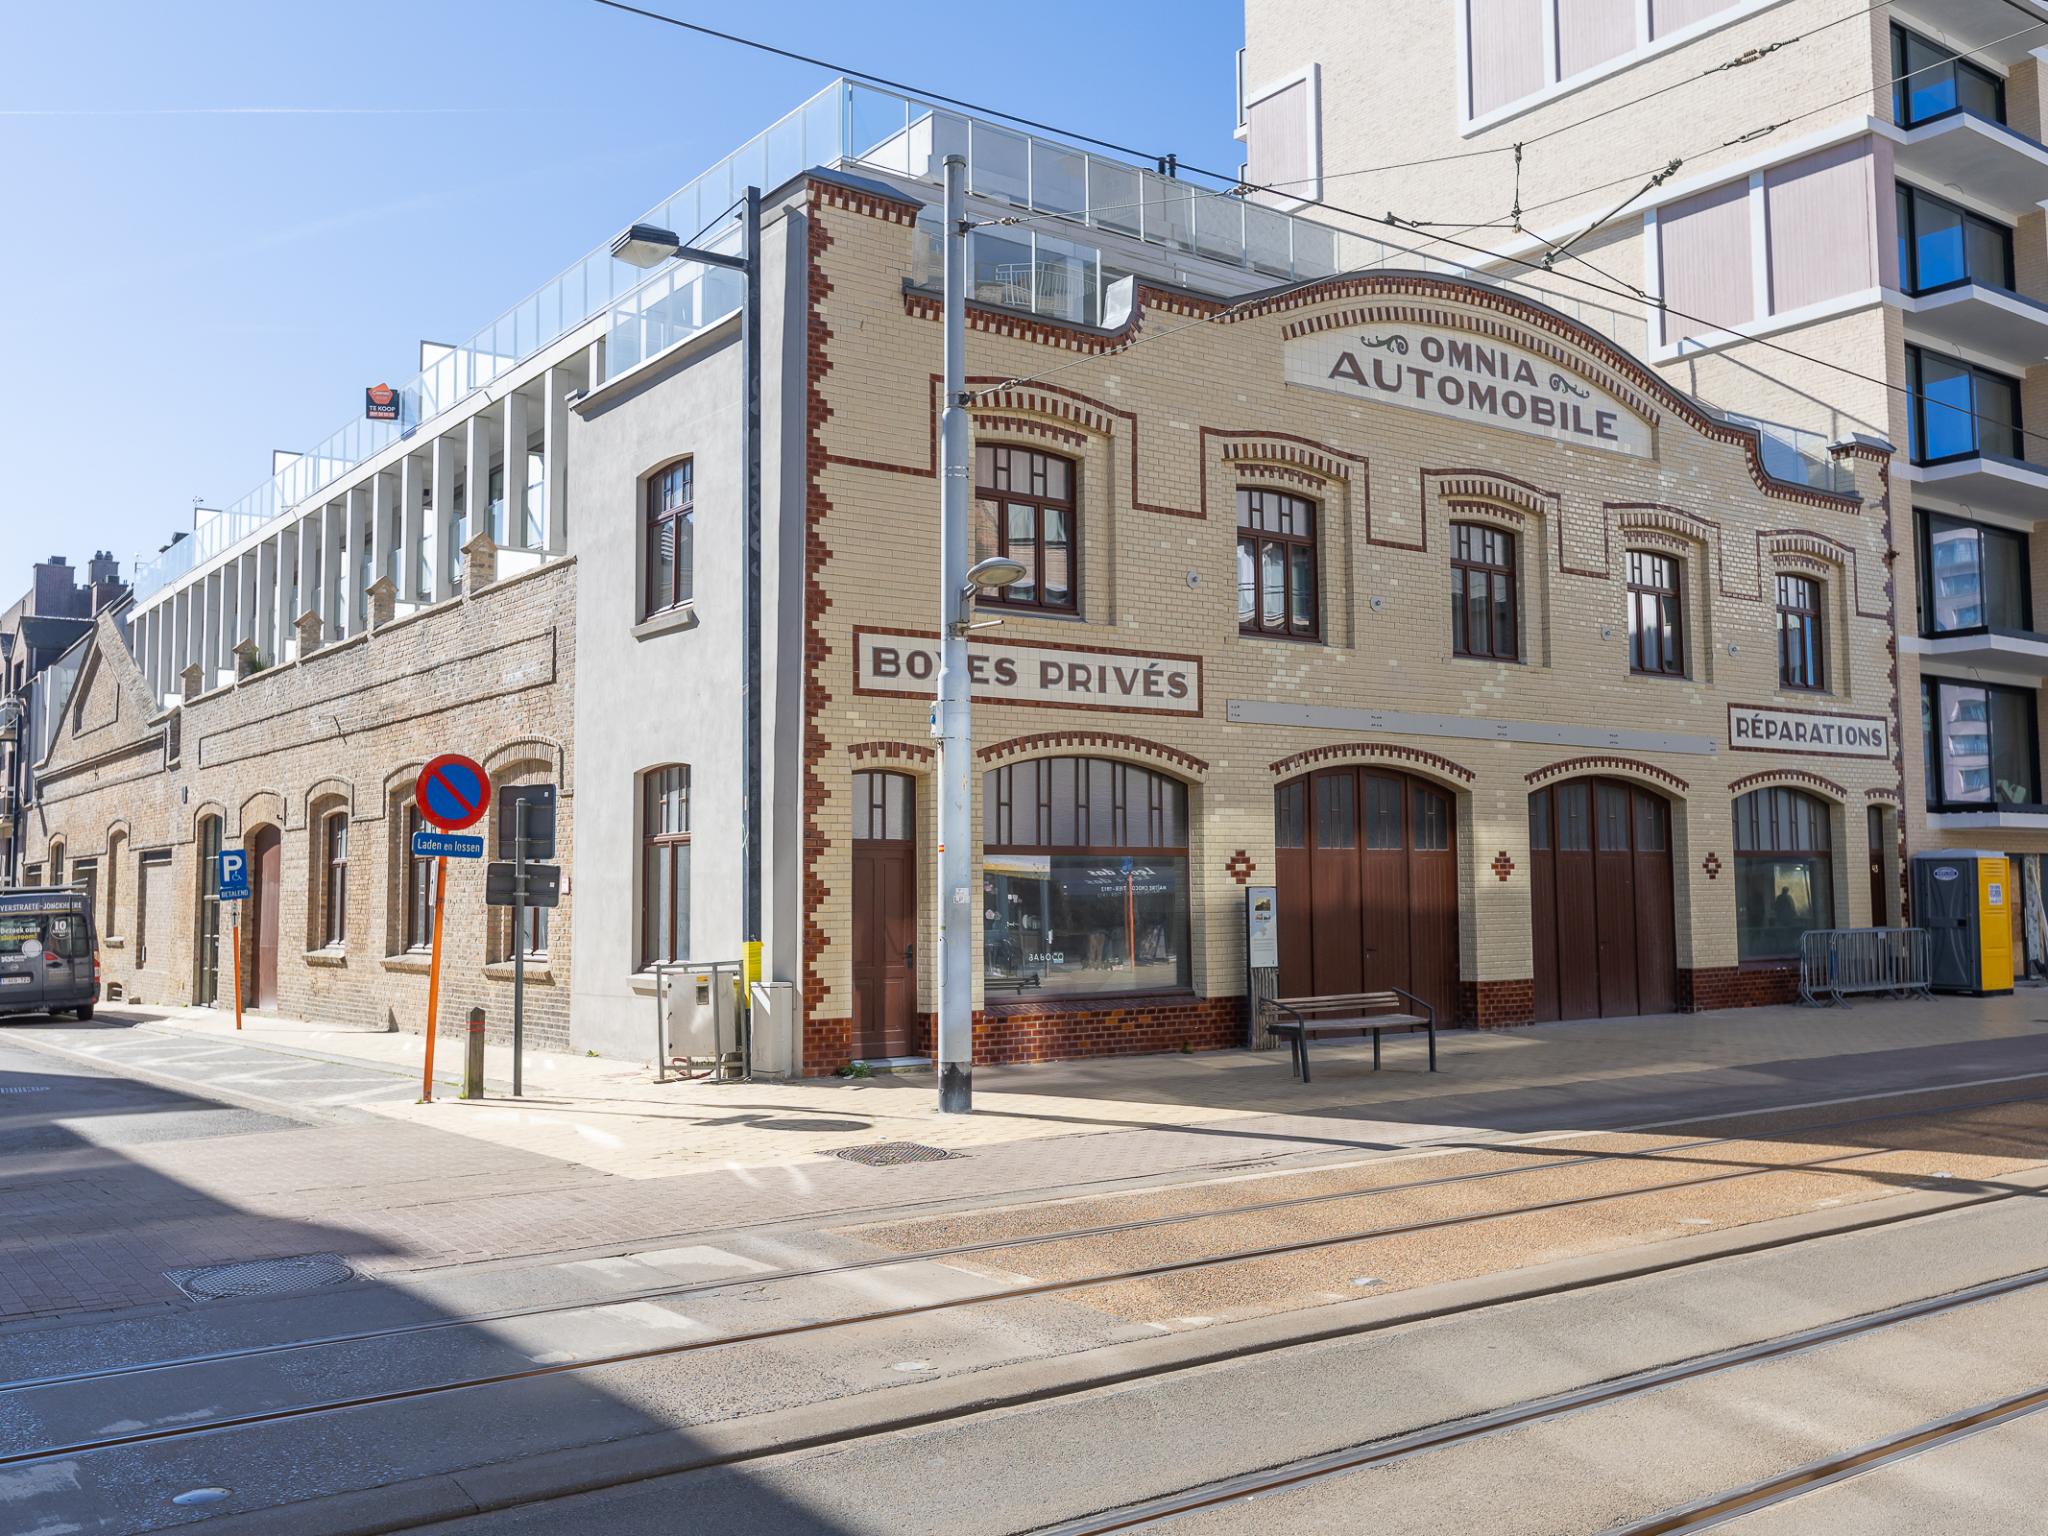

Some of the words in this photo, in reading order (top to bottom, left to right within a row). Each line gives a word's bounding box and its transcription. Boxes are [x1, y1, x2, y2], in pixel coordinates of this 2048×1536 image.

[1420, 336, 1538, 387] OMNIA
[1328, 351, 1619, 441] AUTOMOBILE
[872, 646, 1018, 687] BOES
[1039, 661, 1188, 698] PRIVÉS
[1736, 713, 1883, 747] RÉPARATIONS
[417, 838, 442, 850] Laden
[443, 844, 453, 852] en
[454, 841, 480, 853] lossen
[223, 855, 243, 882] P
[55, 920, 67, 930] 10
